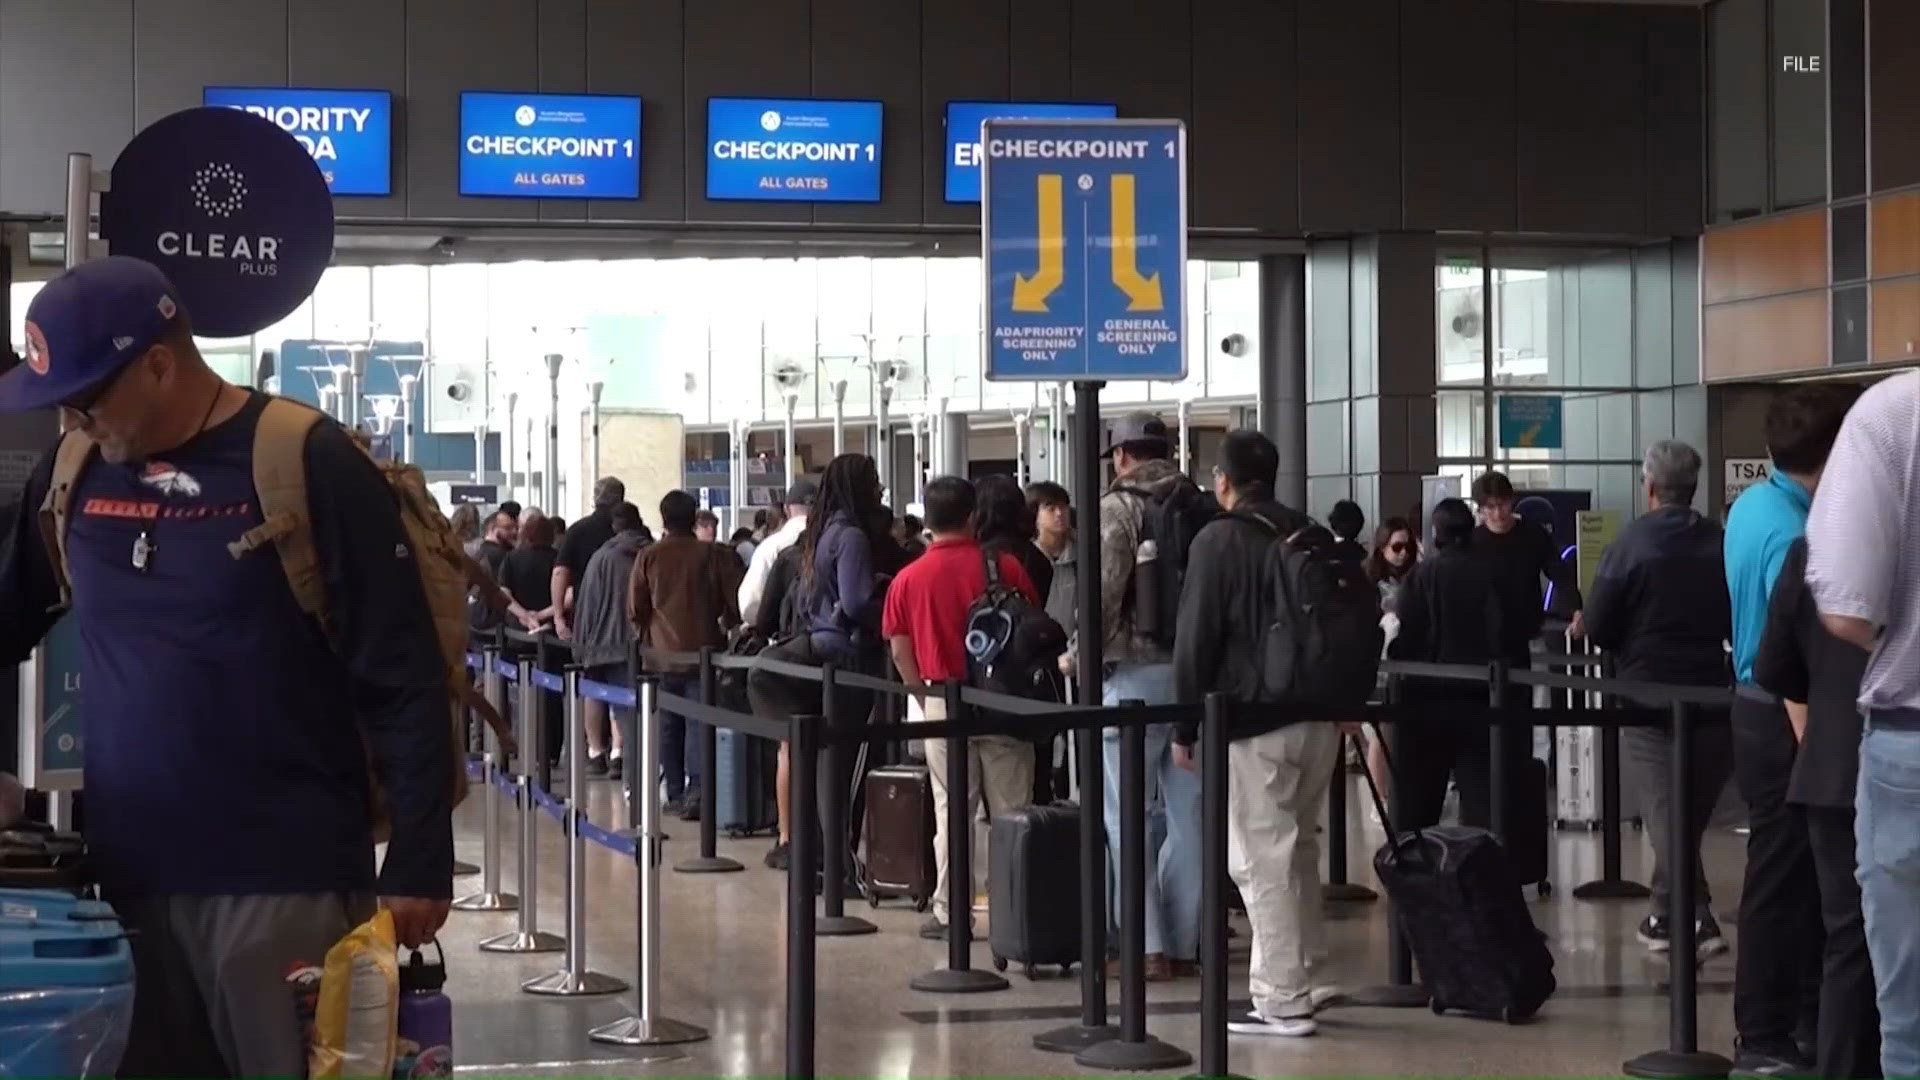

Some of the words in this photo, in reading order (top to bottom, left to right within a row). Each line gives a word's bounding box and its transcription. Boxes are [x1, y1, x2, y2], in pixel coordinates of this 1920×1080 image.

[466, 135, 618, 157] CHECKPOINT
[623, 139, 633, 158] 1
[713, 140, 860, 161] CHECKPOINT
[864, 143, 875, 162] 1
[989, 139, 1149, 158] CHECKPOINT
[1164, 141, 1175, 159] 1
[514, 172, 538, 185] ALL
[541, 173, 586, 186] GATES
[759, 176, 782, 189] ALL
[785, 176, 829, 189] GATES
[156, 231, 279, 261] CLEAR
[239, 263, 278, 276] PLUS
[1104, 319, 1170, 331] GENERAL
[994, 326, 1084, 338] ADA/PRIORITY
[1096, 331, 1178, 343] SCREENING
[1002, 339, 1077, 349] SCREENING
[1118, 343, 1157, 355] ONLY
[1022, 350, 1058, 361] ONLY
[1732, 462, 1768, 479] TSA
